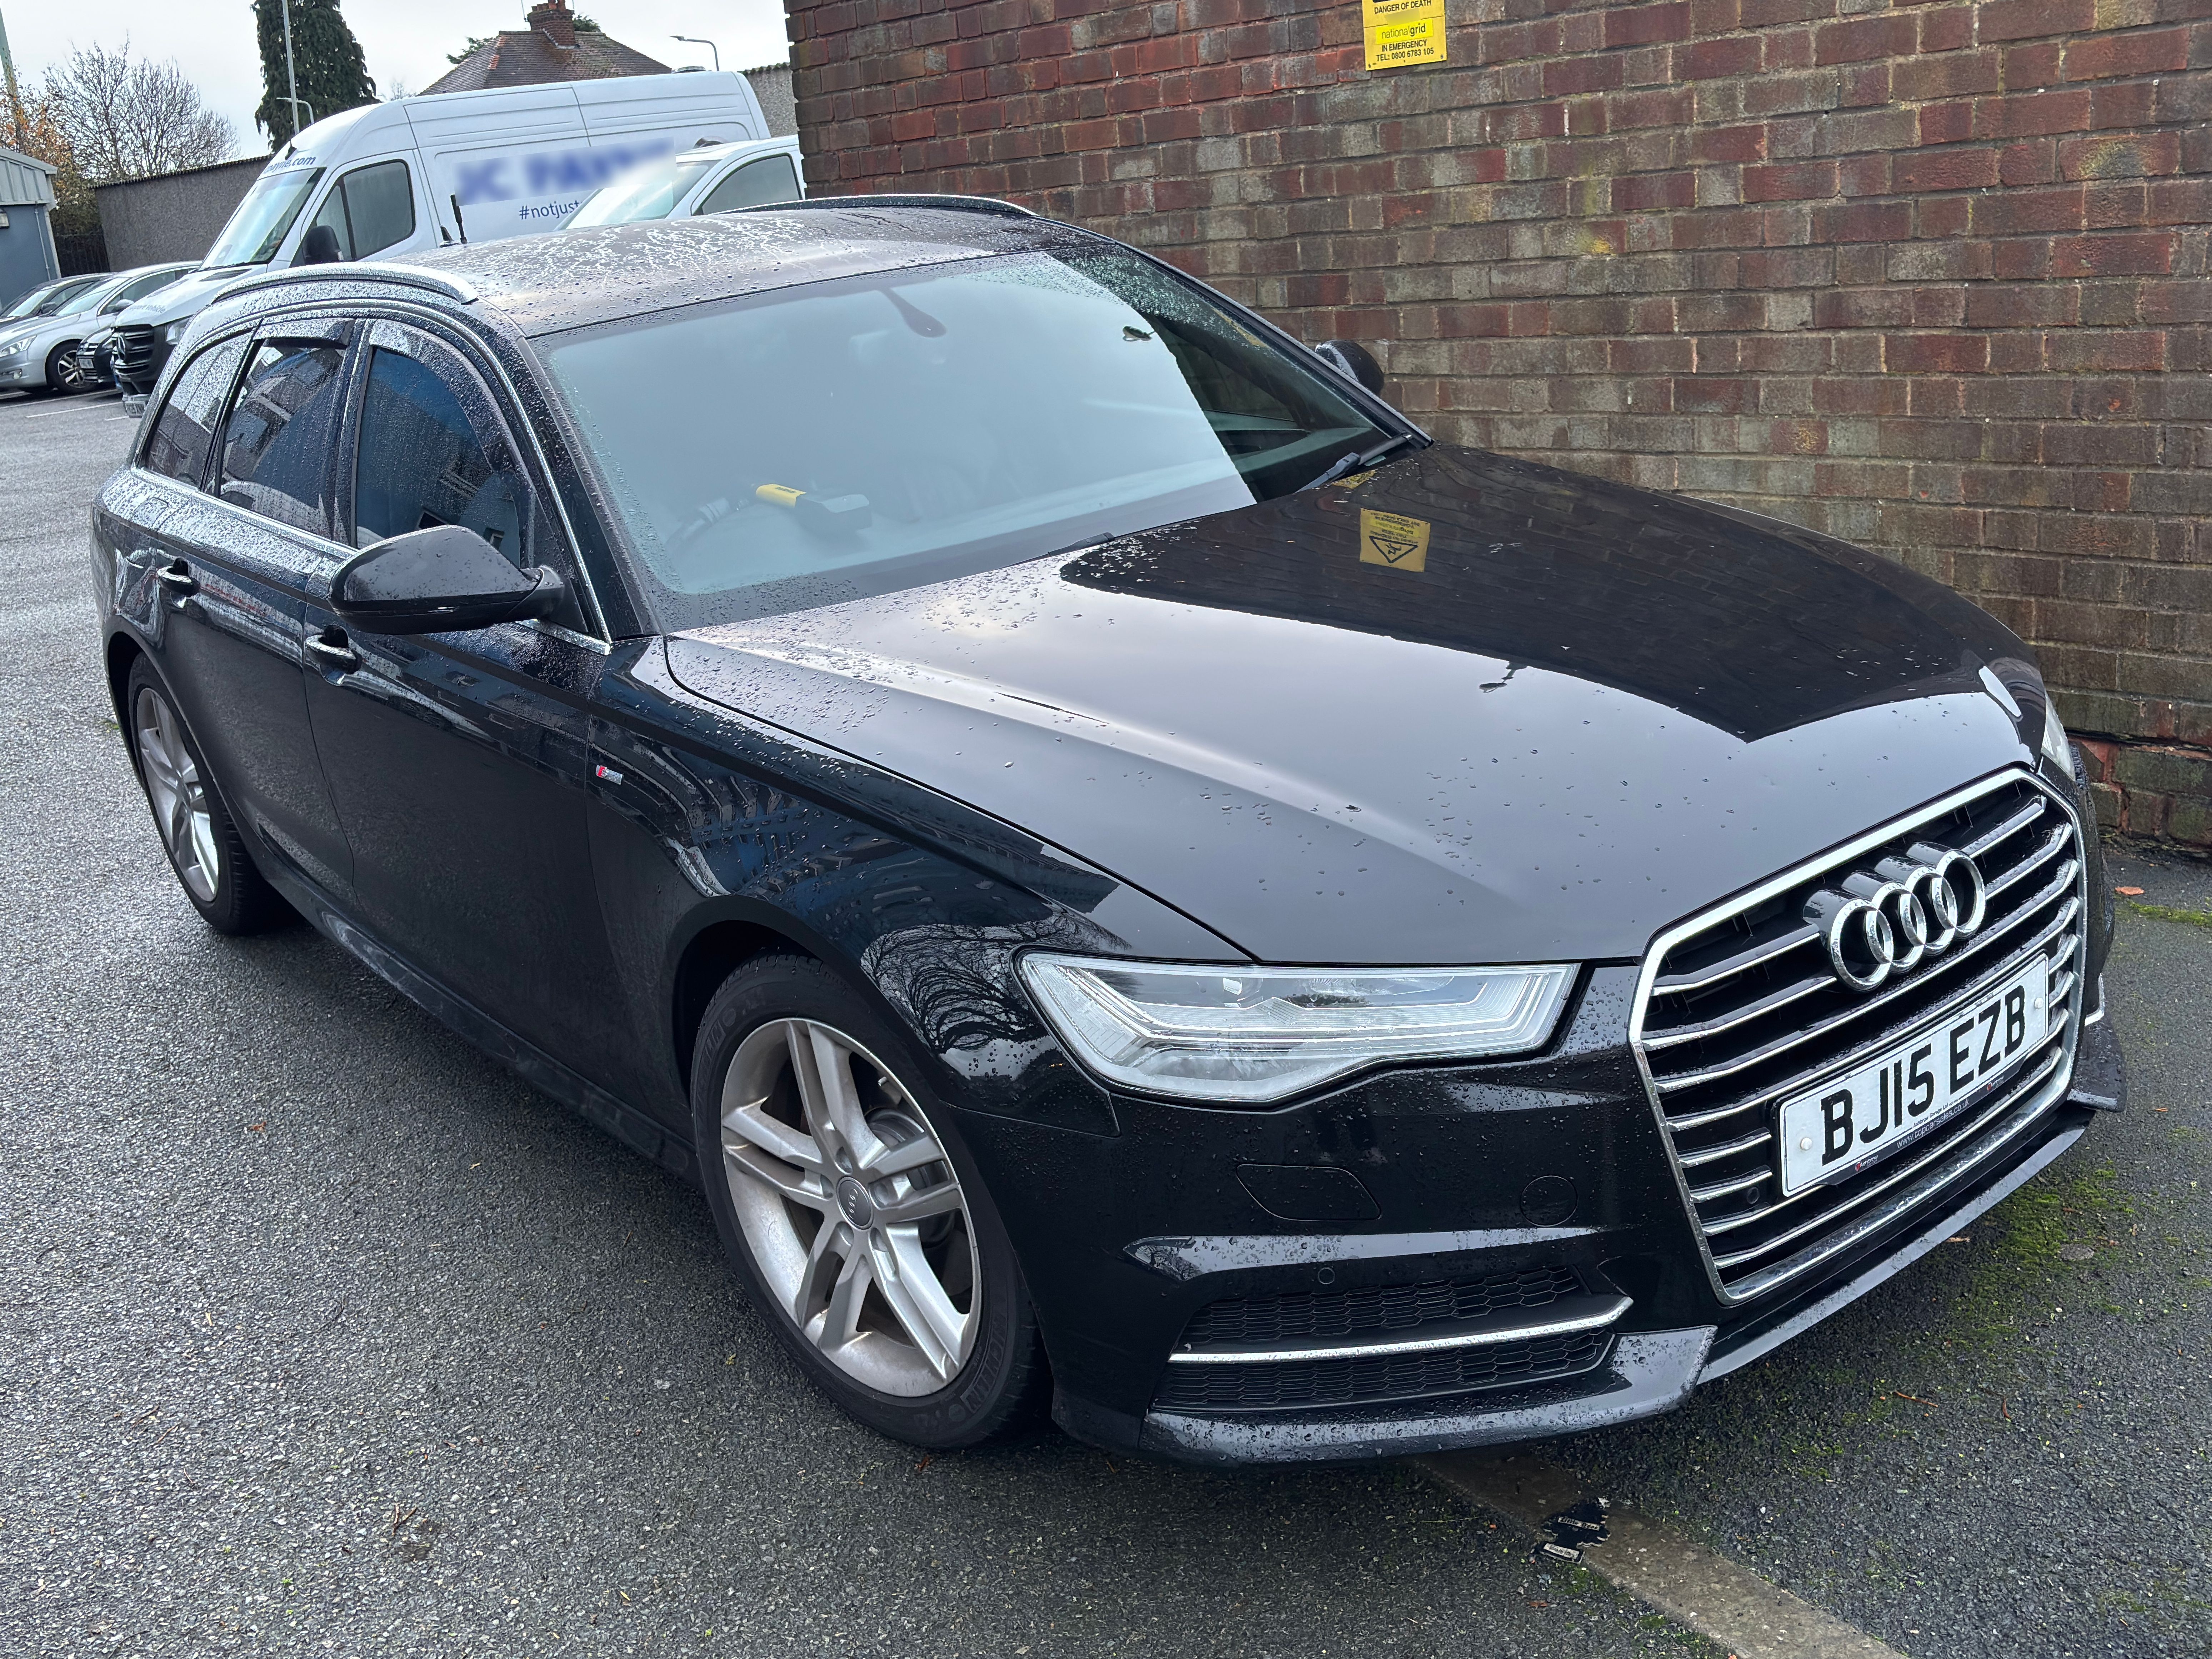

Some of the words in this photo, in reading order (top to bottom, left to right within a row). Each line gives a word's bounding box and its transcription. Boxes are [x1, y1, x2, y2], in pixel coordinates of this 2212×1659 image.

[1374, 4, 1399, 14] DANGER
[1411, 0, 1431, 8] DEATH
[1382, 23, 1426, 39] nationalgrid
[1389, 39, 1427, 51] EMERGENCY
[1407, 49, 1421, 57] 6783
[519, 200, 582, 220] #notjust
[1821, 1043, 1935, 1166] BJ15
[1949, 985, 2025, 1095] EZB
[1897, 1098, 1969, 1149] www.topcarsales.co.uk
